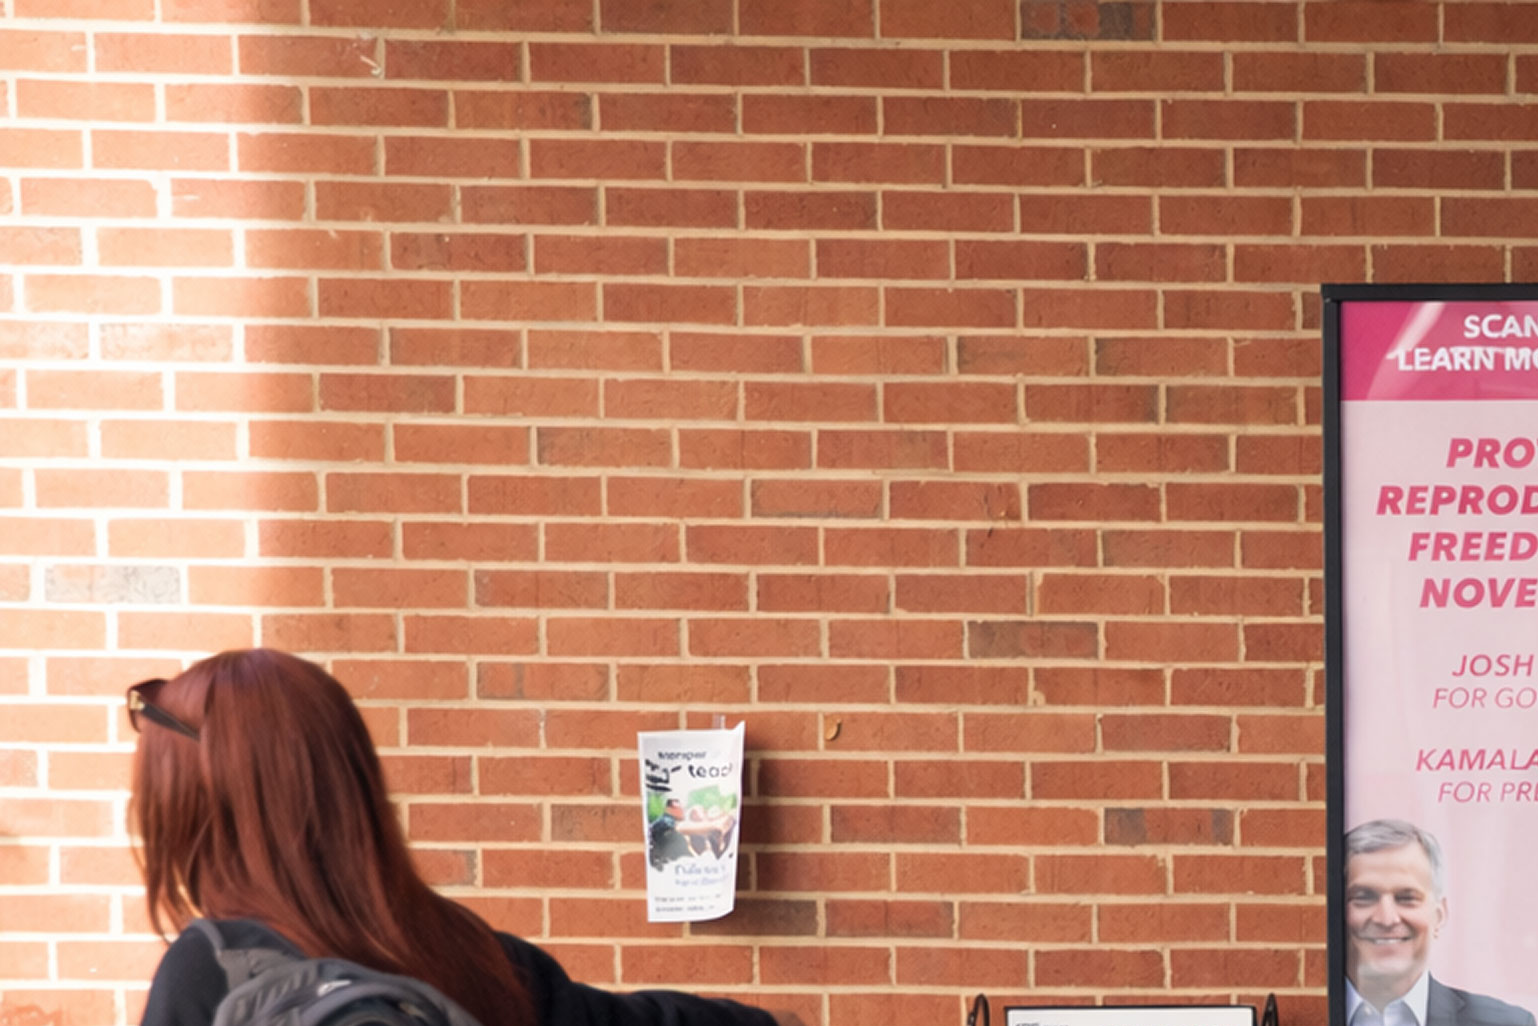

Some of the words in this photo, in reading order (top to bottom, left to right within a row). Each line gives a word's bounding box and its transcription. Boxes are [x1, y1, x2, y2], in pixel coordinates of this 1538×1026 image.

[1398, 347, 1495, 371] LEARN
[1452, 654, 1535, 677] JOSH
[1432, 687, 1487, 709] FOR
[1437, 781, 1491, 803] FOR
